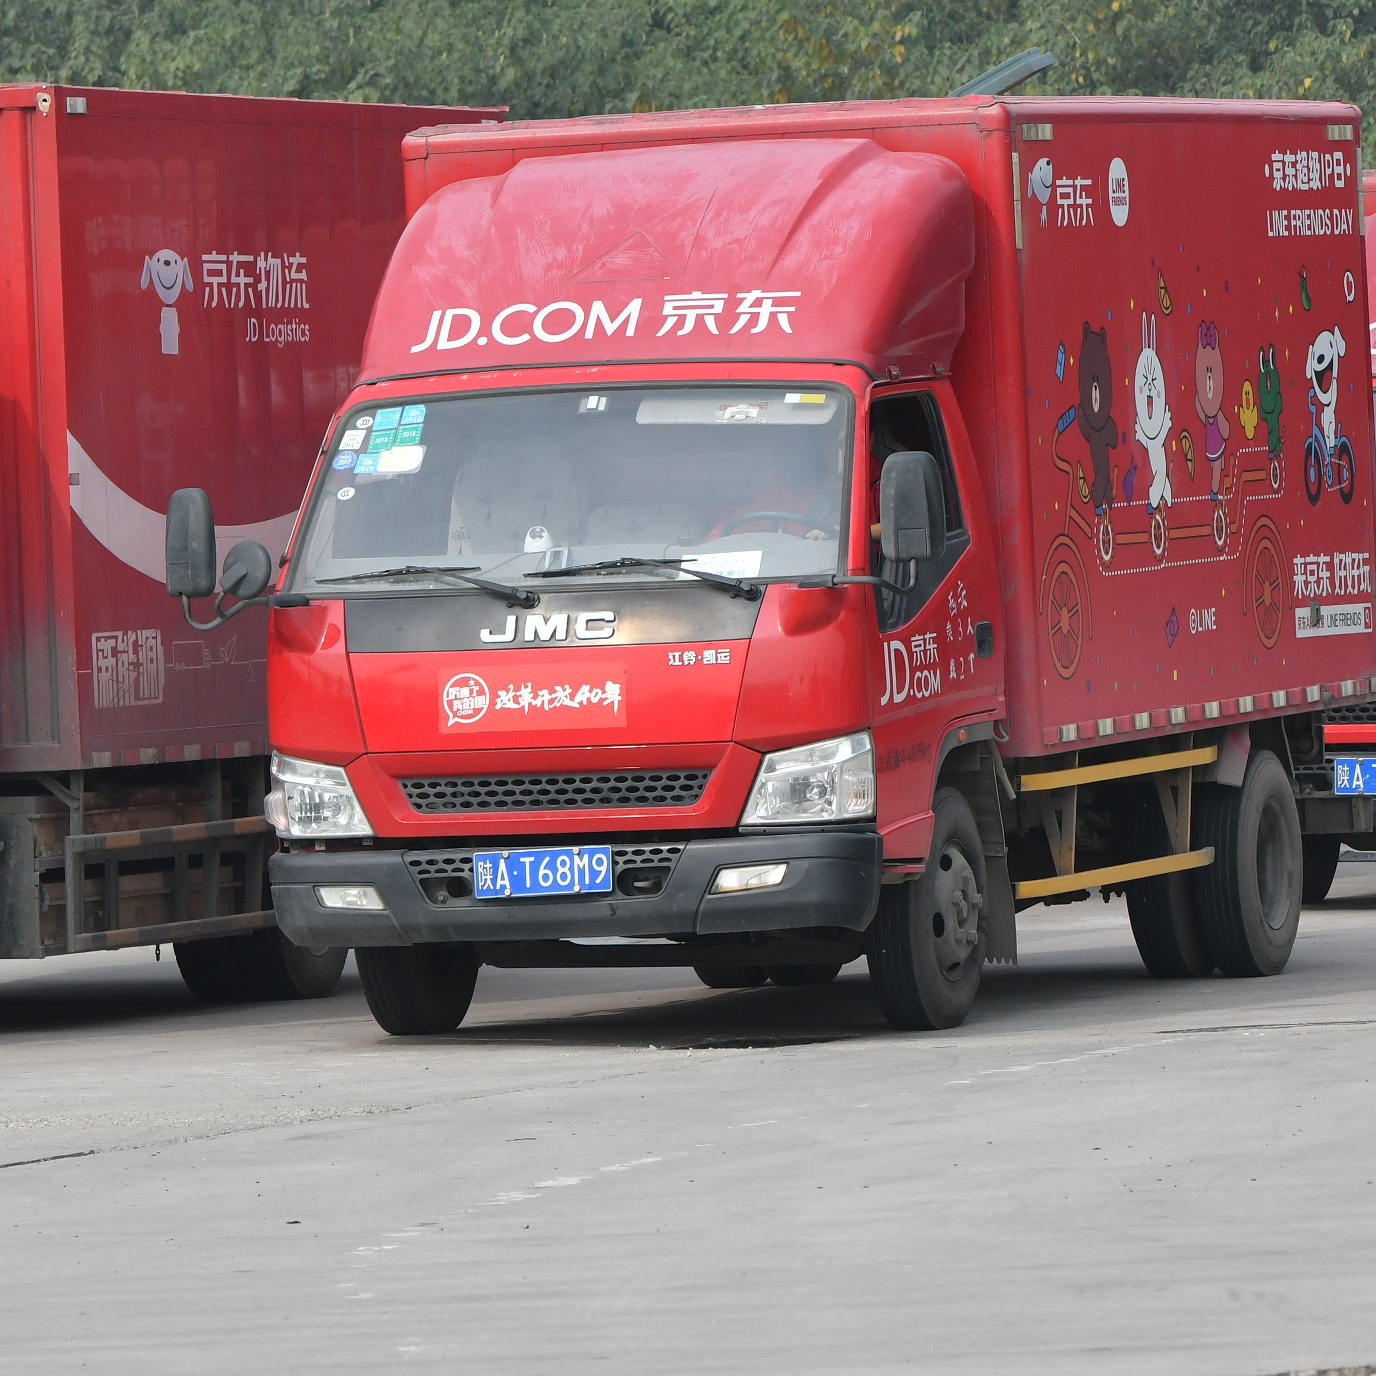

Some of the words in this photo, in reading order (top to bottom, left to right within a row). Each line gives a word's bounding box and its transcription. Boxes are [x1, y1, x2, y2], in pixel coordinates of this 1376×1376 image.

[1055, 175, 1095, 227] 京东
[1111, 178, 1126, 194] LINE
[1111, 196, 1128, 207] FRIENDS
[1267, 210, 1289, 237] LINE
[1290, 209, 1332, 236] FRIENDS
[1333, 209, 1354, 235] DAY
[201, 250, 310, 309] 京东物流
[245, 317, 259, 343] JD
[263, 317, 310, 349] Logistics
[409, 297, 643, 354] JD.COM
[655, 289, 802, 337] 京东
[1293, 554, 1332, 598] 来京东
[1334, 551, 1372, 596] 好好玩
[480, 611, 617, 643] JMC
[1327, 613, 1339, 628] LINE
[1339, 611, 1362, 627] FRIENDS
[667, 648, 731, 666] 江铃·凯运
[911, 632, 939, 667] 京东
[495, 680, 622, 717] 改革开放40年
